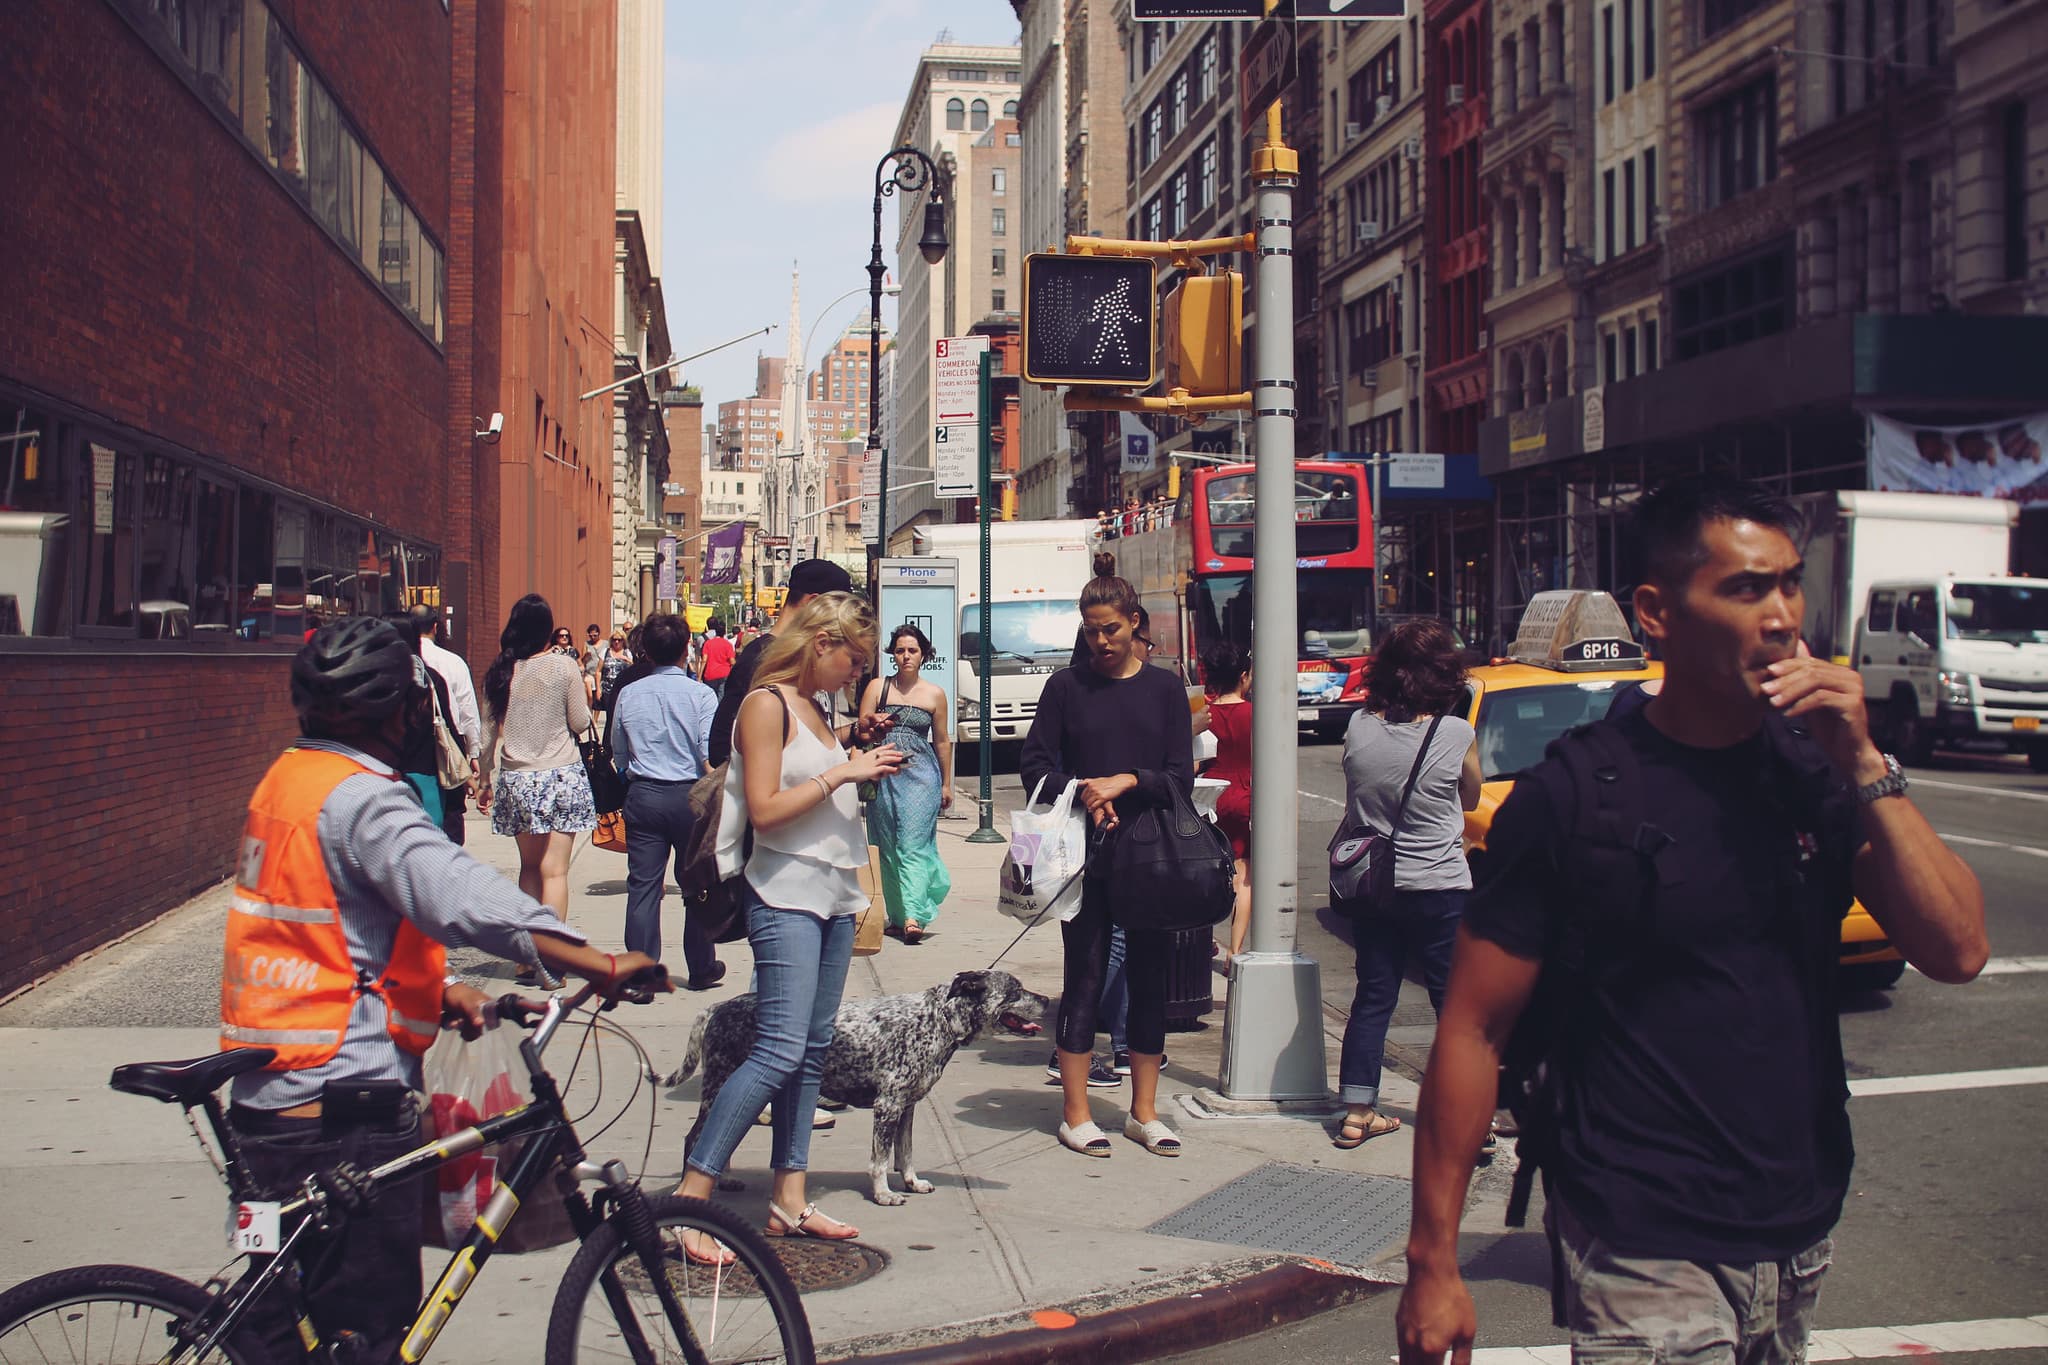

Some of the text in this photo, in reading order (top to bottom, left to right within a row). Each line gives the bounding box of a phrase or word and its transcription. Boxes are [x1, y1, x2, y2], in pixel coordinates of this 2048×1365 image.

[938, 342, 947, 357] 3
[938, 359, 980, 369] COMMERCIAL
[938, 368, 980, 377] VEHICLES ON
[937, 427, 946, 442] 2
[899, 567, 937, 577] Phone
[1583, 643, 1619, 659] 6P16
[1021, 665, 1055, 673] ISUZU
[243, 1233, 263, 1247] 10
